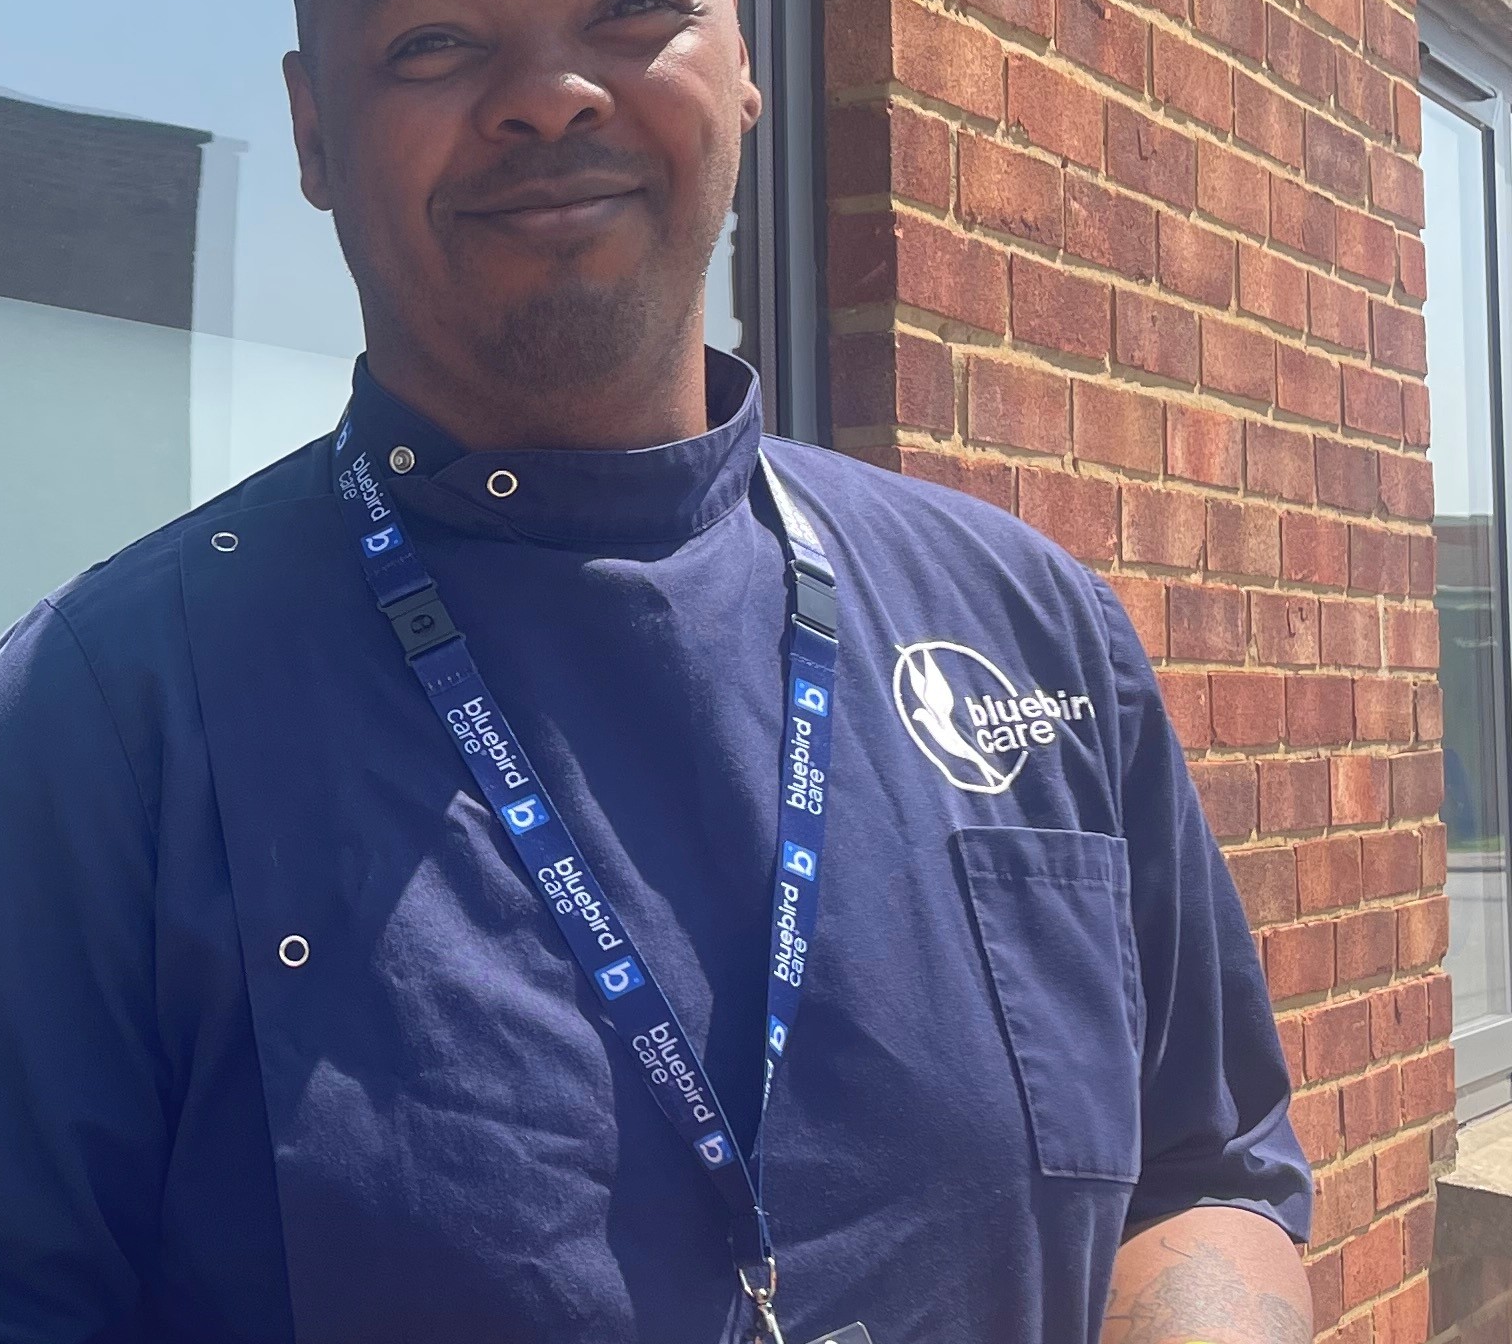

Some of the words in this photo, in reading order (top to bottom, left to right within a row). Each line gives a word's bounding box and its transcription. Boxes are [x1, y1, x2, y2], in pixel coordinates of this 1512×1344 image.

[338, 468, 358, 501] care
[351, 451, 392, 522] bluebird
[446, 706, 482, 756] care
[963, 688, 1097, 727] bluebir
[462, 695, 530, 789] bluebird
[976, 719, 1056, 754] care
[786, 716, 812, 810] bluebird
[807, 768, 825, 816] care
[537, 866, 573, 916] care
[553, 856, 624, 952] bluebird
[773, 881, 800, 982] bluebird
[788, 936, 809, 988] care
[632, 1034, 669, 1085] care
[648, 1021, 716, 1124] bluebird
